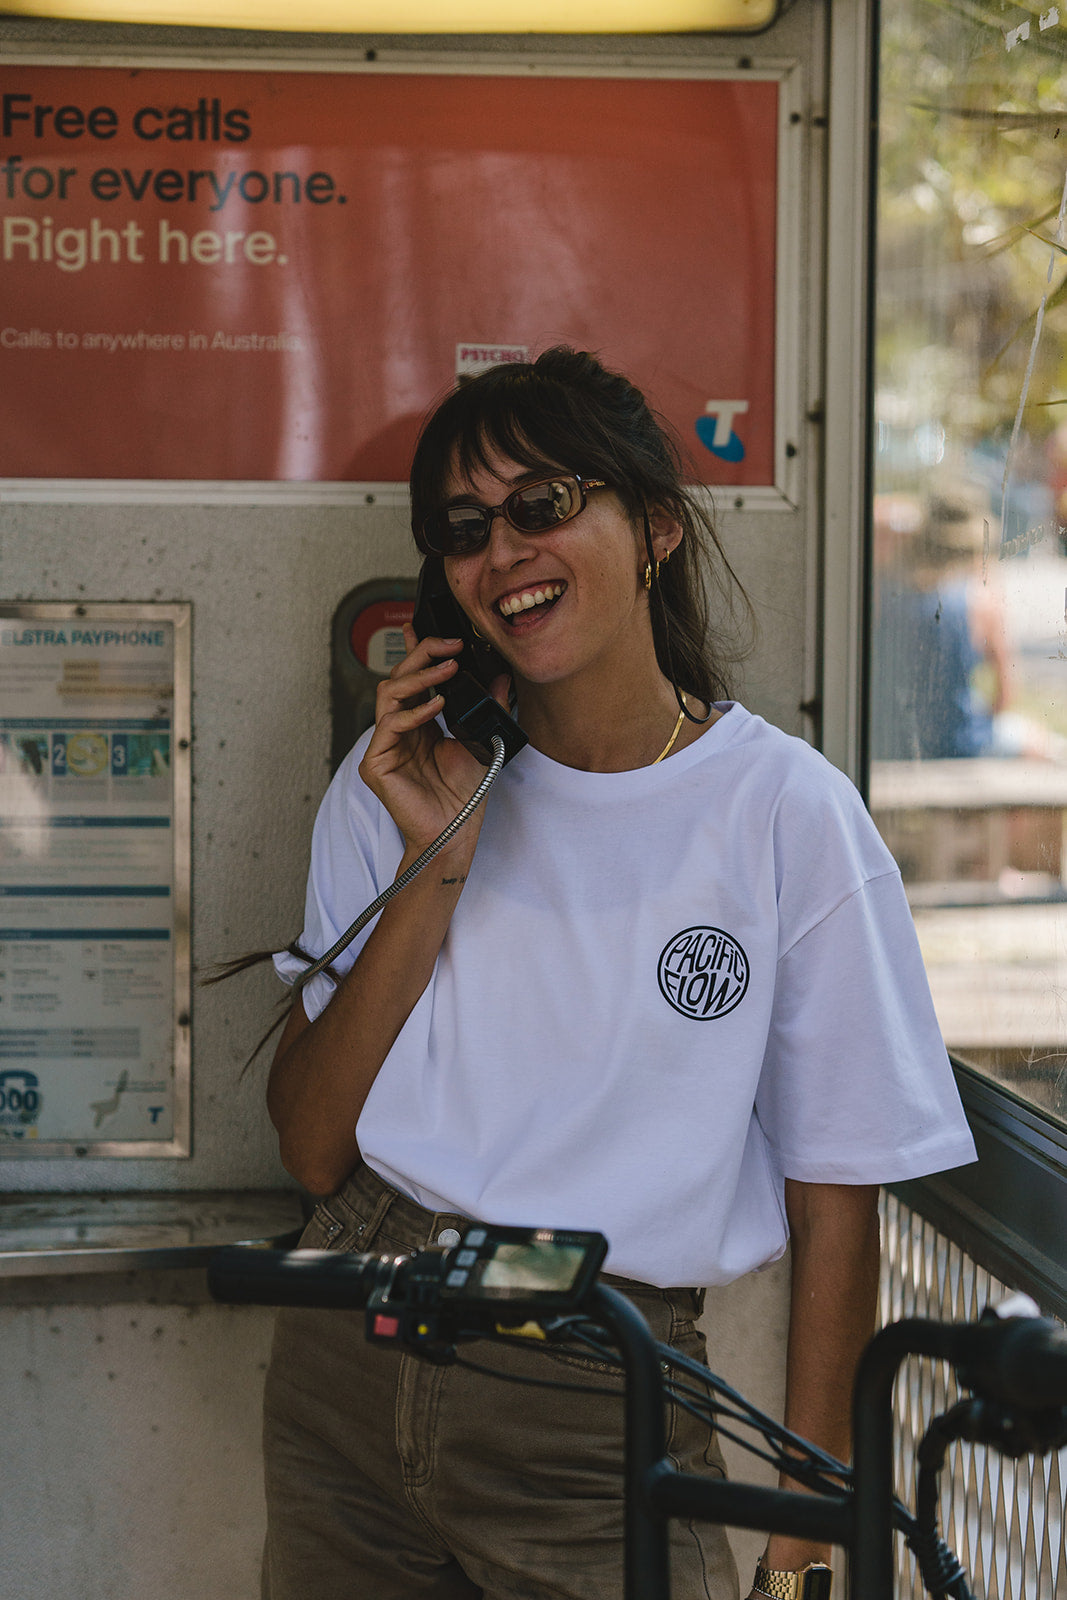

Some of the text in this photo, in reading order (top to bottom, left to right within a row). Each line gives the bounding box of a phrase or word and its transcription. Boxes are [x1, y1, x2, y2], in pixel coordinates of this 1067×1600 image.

[2, 94, 251, 142] Free calls
[1, 156, 347, 211] for everyone.
[3, 217, 288, 272] Right here.
[1, 328, 52, 349] Calls
[57, 330, 78, 349] to
[82, 330, 185, 353] anywhere
[189, 331, 208, 349] in
[71, 629, 165, 646] PAYPHONE
[54, 744, 66, 767] 2
[113, 745, 125, 768] 3
[664, 968, 742, 1015] FLOW
